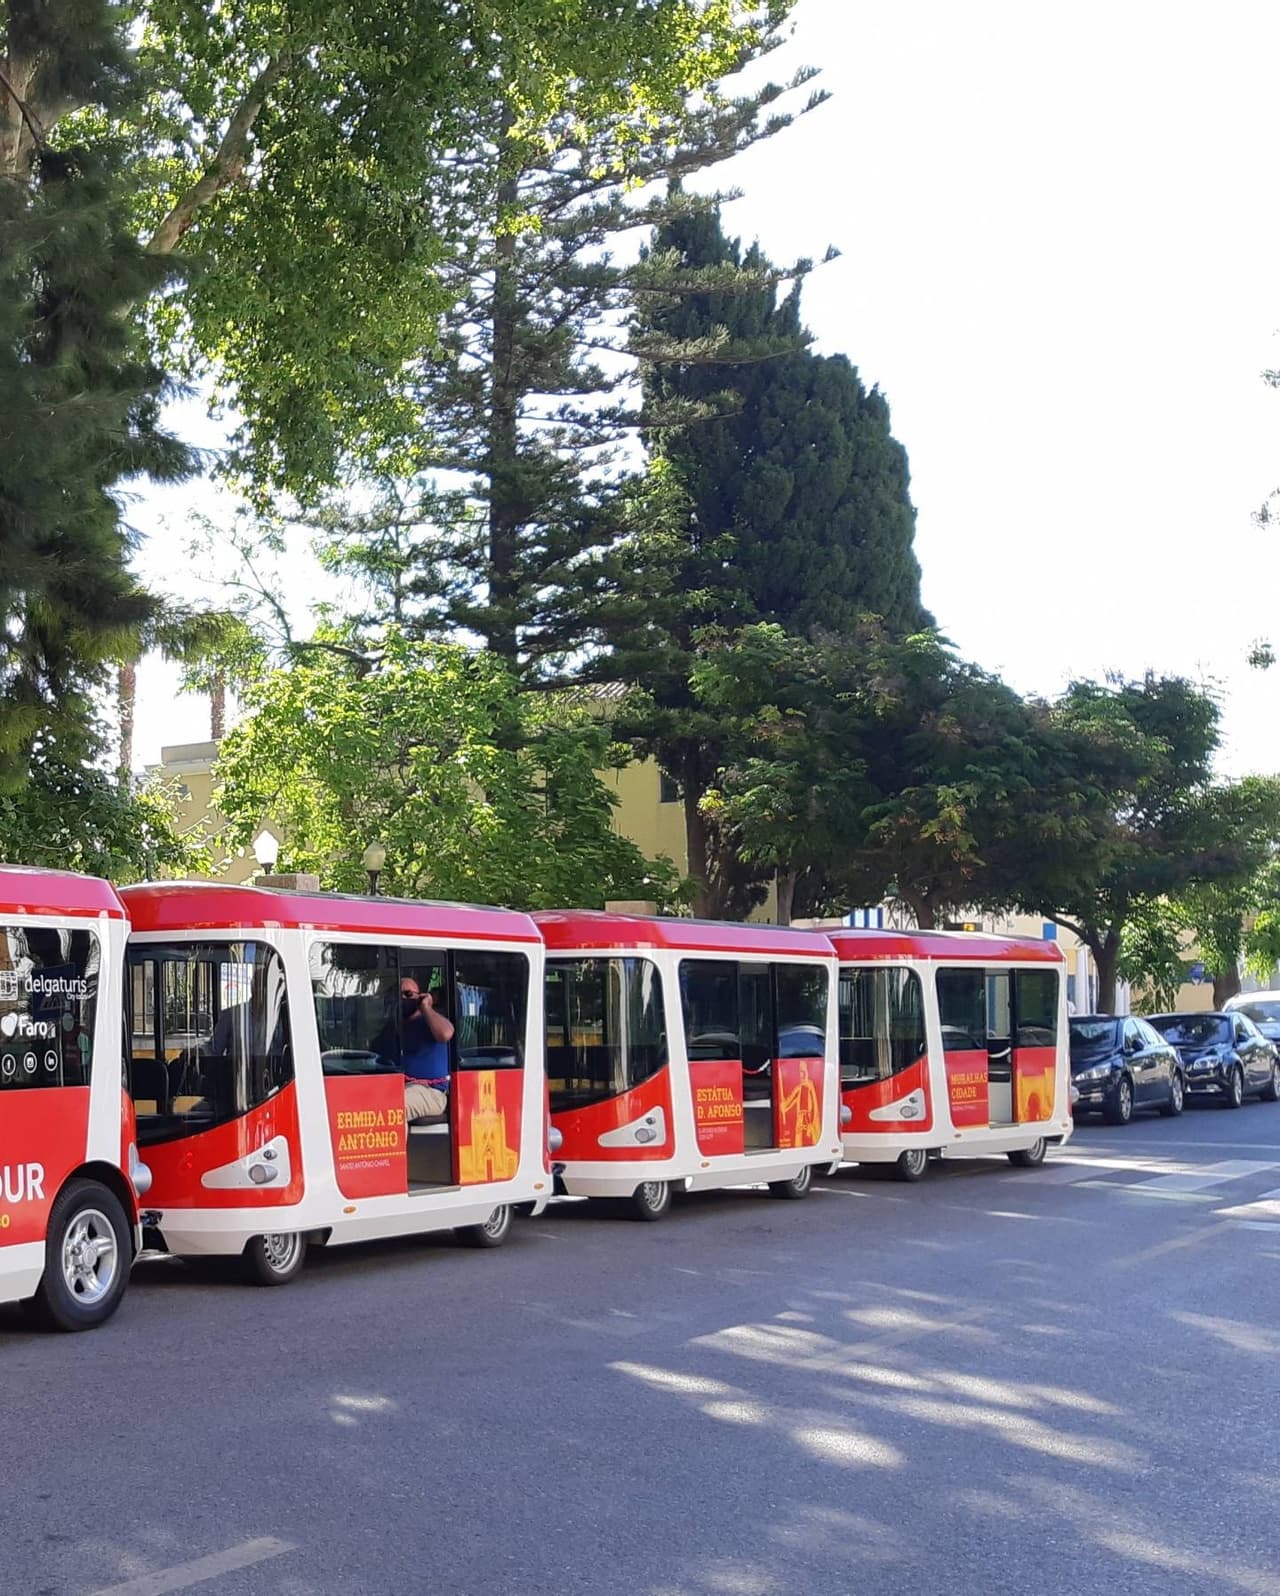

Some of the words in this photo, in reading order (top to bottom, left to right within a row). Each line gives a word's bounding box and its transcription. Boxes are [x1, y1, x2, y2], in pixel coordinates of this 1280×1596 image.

[24, 975, 87, 997] delgaturis
[19, 1015, 48, 1037] Faro
[697, 1085, 733, 1101] ESTÁTUA
[952, 1087, 977, 1099] CIDADE
[337, 1110, 385, 1129] ERMIDA
[387, 1109, 404, 1125] DE
[697, 1105, 706, 1119] D.
[707, 1103, 741, 1118] AFONSO
[338, 1127, 398, 1151] ANTÓNIO
